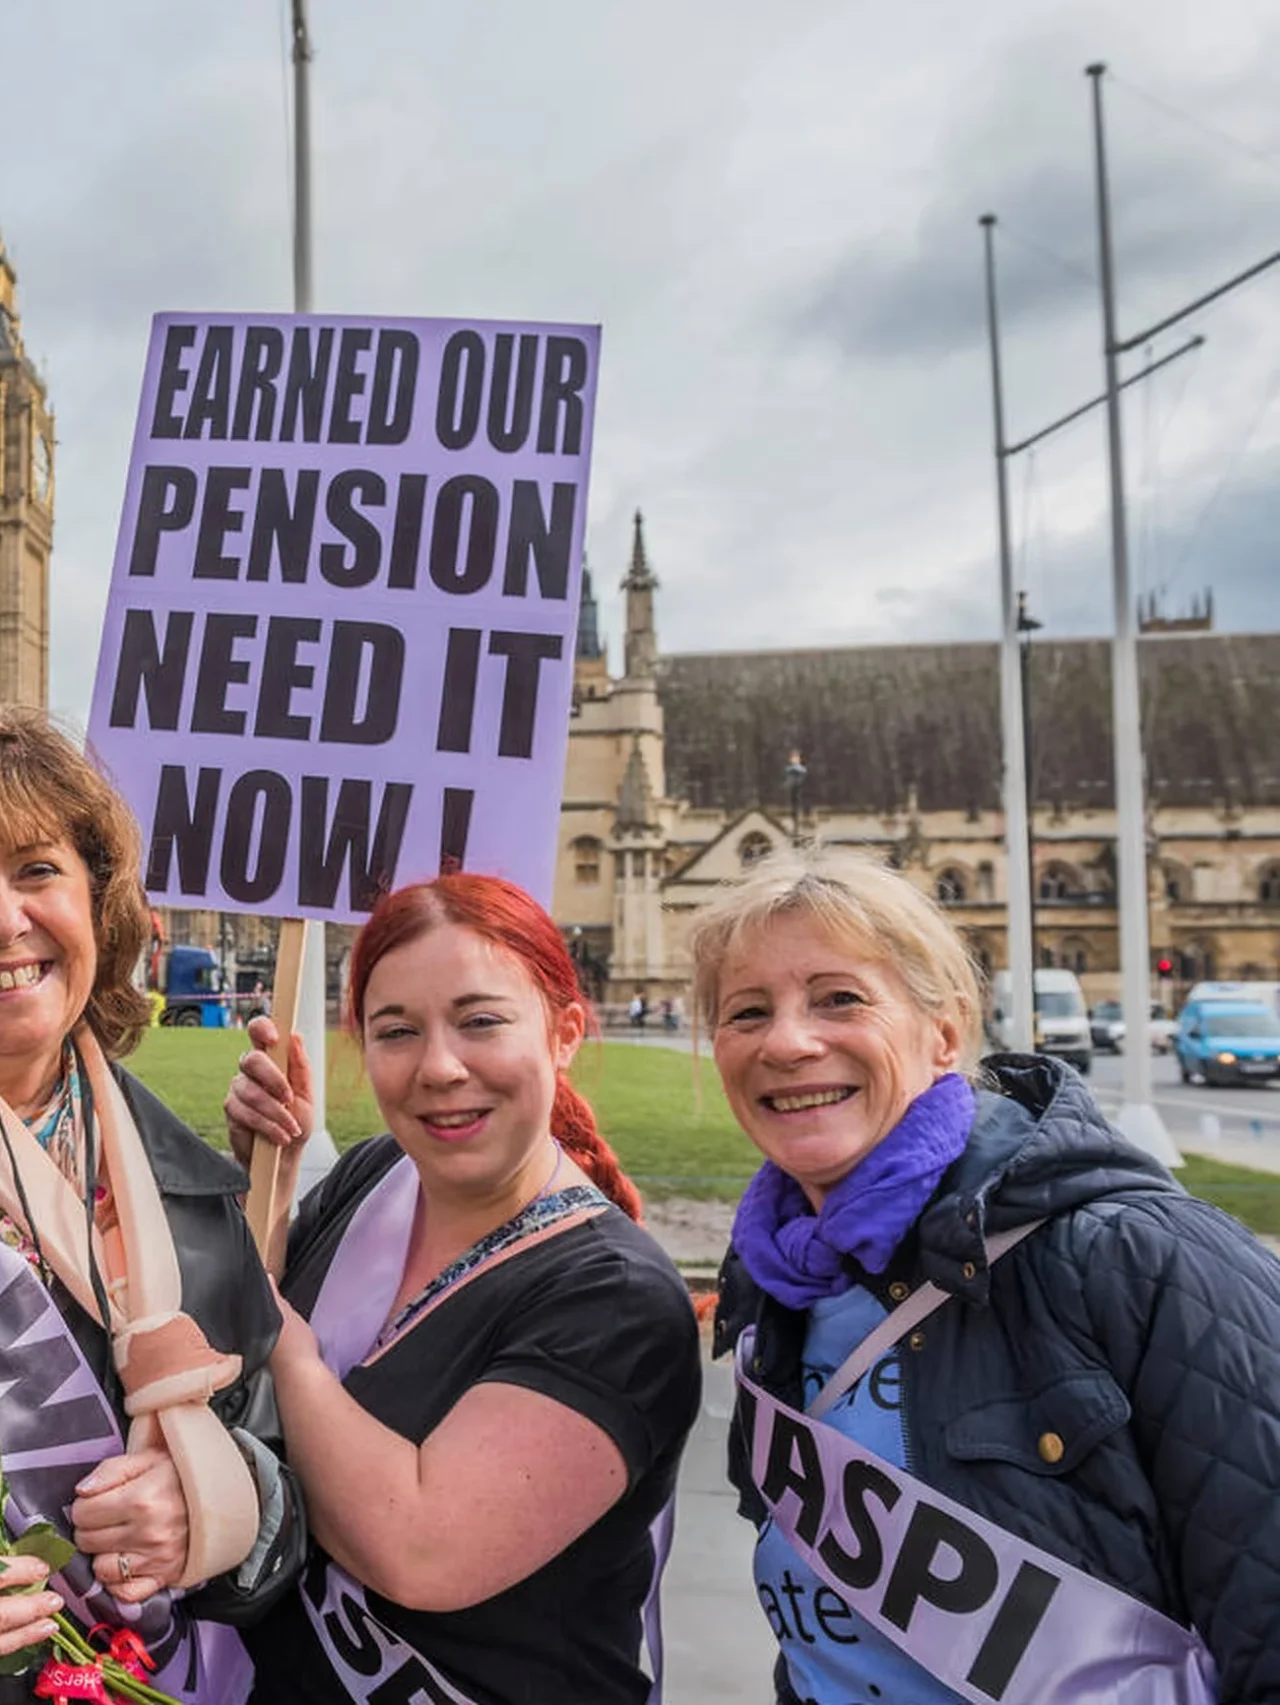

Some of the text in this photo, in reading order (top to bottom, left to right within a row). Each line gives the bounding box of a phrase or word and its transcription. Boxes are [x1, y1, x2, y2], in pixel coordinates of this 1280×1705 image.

[150, 325, 589, 456] EARNED OUR
[128, 465, 578, 600] PENSION
[109, 609, 563, 759] NEED IT
[740, 1383, 1061, 1702] ASPI
